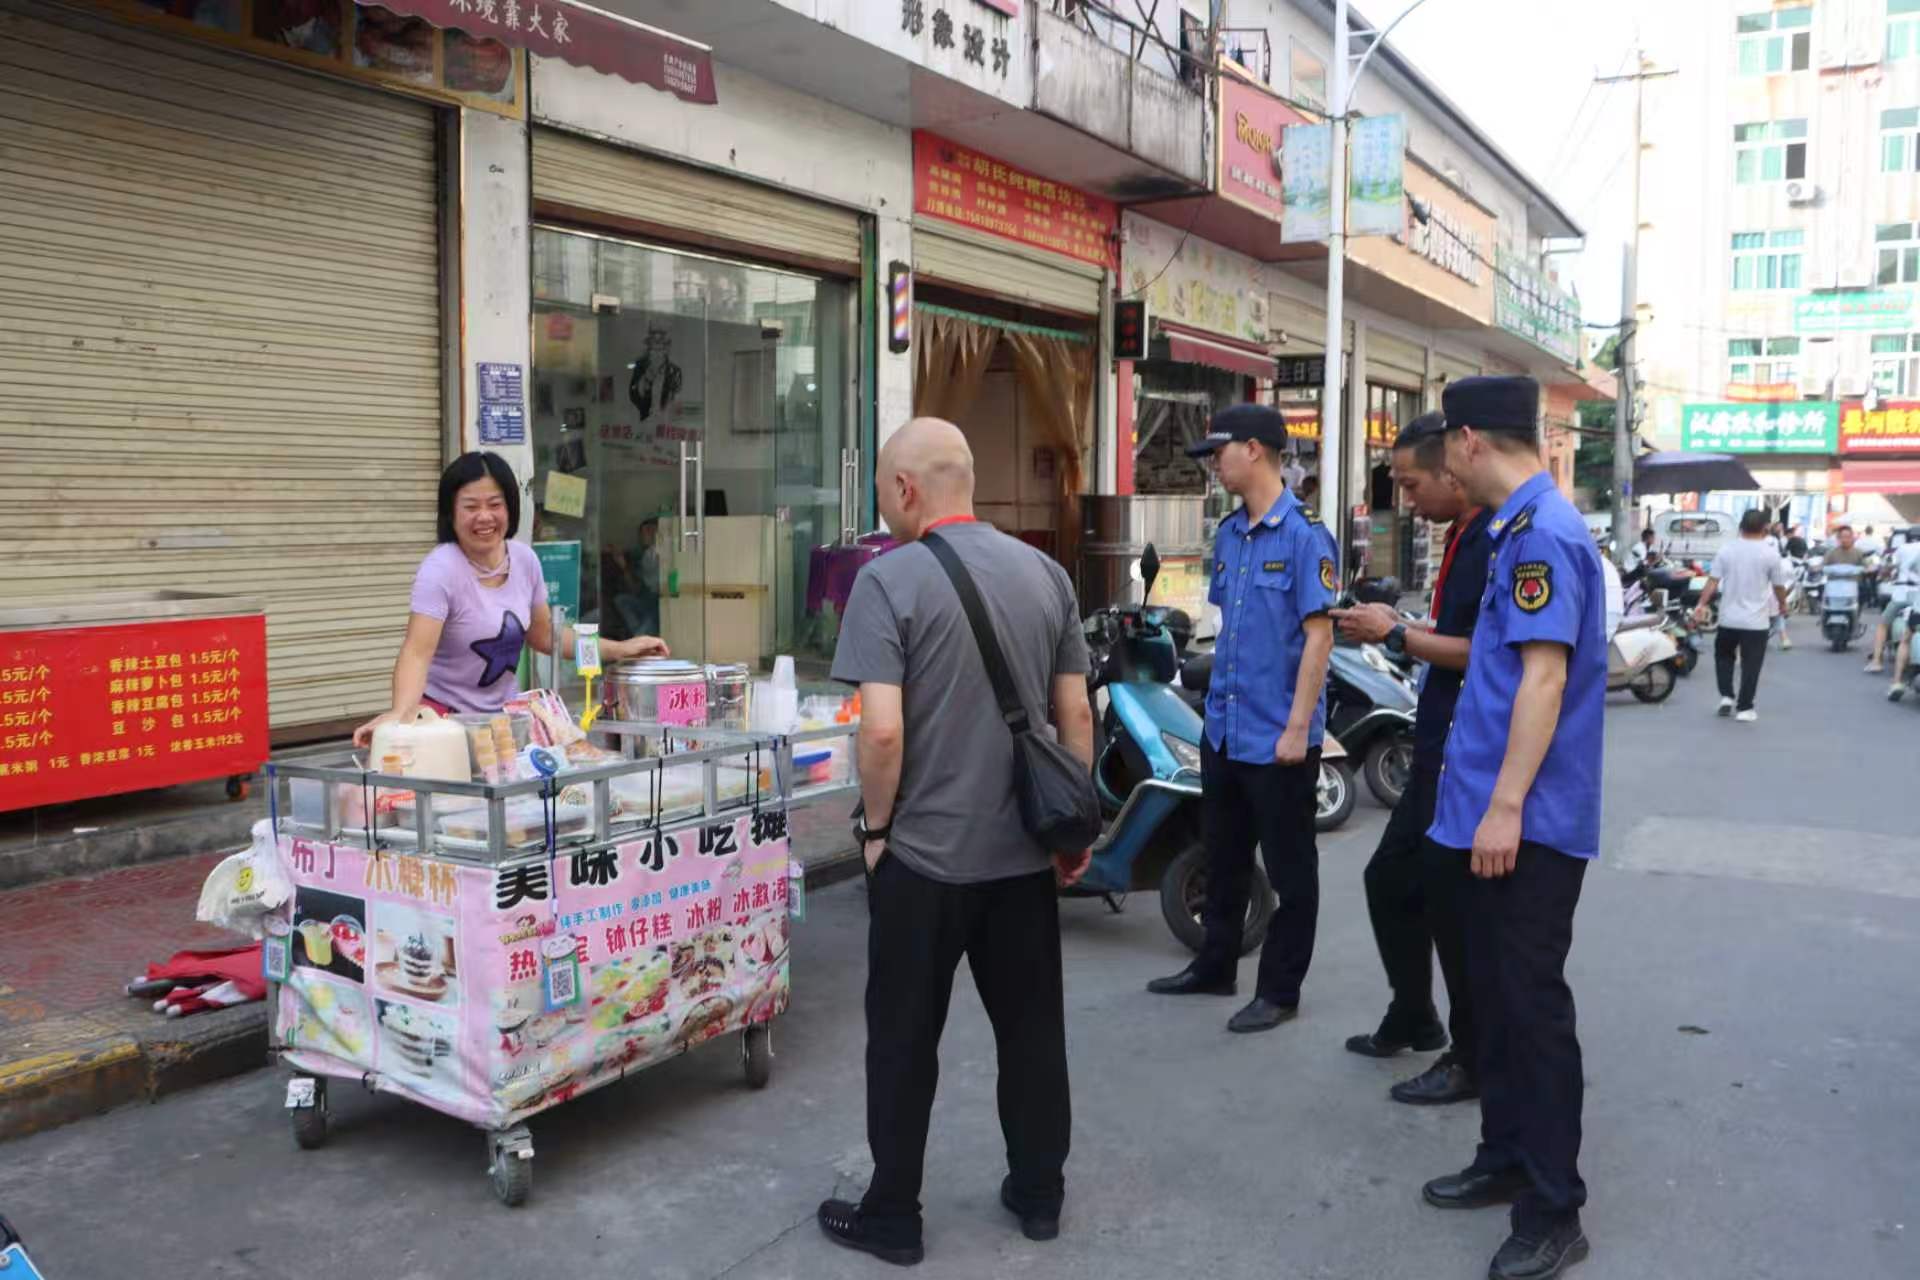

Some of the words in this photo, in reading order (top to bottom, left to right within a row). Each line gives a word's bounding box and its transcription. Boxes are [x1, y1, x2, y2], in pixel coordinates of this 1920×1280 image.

[191, 648, 239, 665] 1.5元/个
[191, 667, 240, 684] 1.5元/个
[192, 687, 240, 705] 1.5元/个
[192, 706, 242, 724] 1.5元/个
[292, 838, 342, 879] 布丁
[496, 810, 787, 909] 美味小吃摊
[606, 913, 673, 955] 钵仔糕
